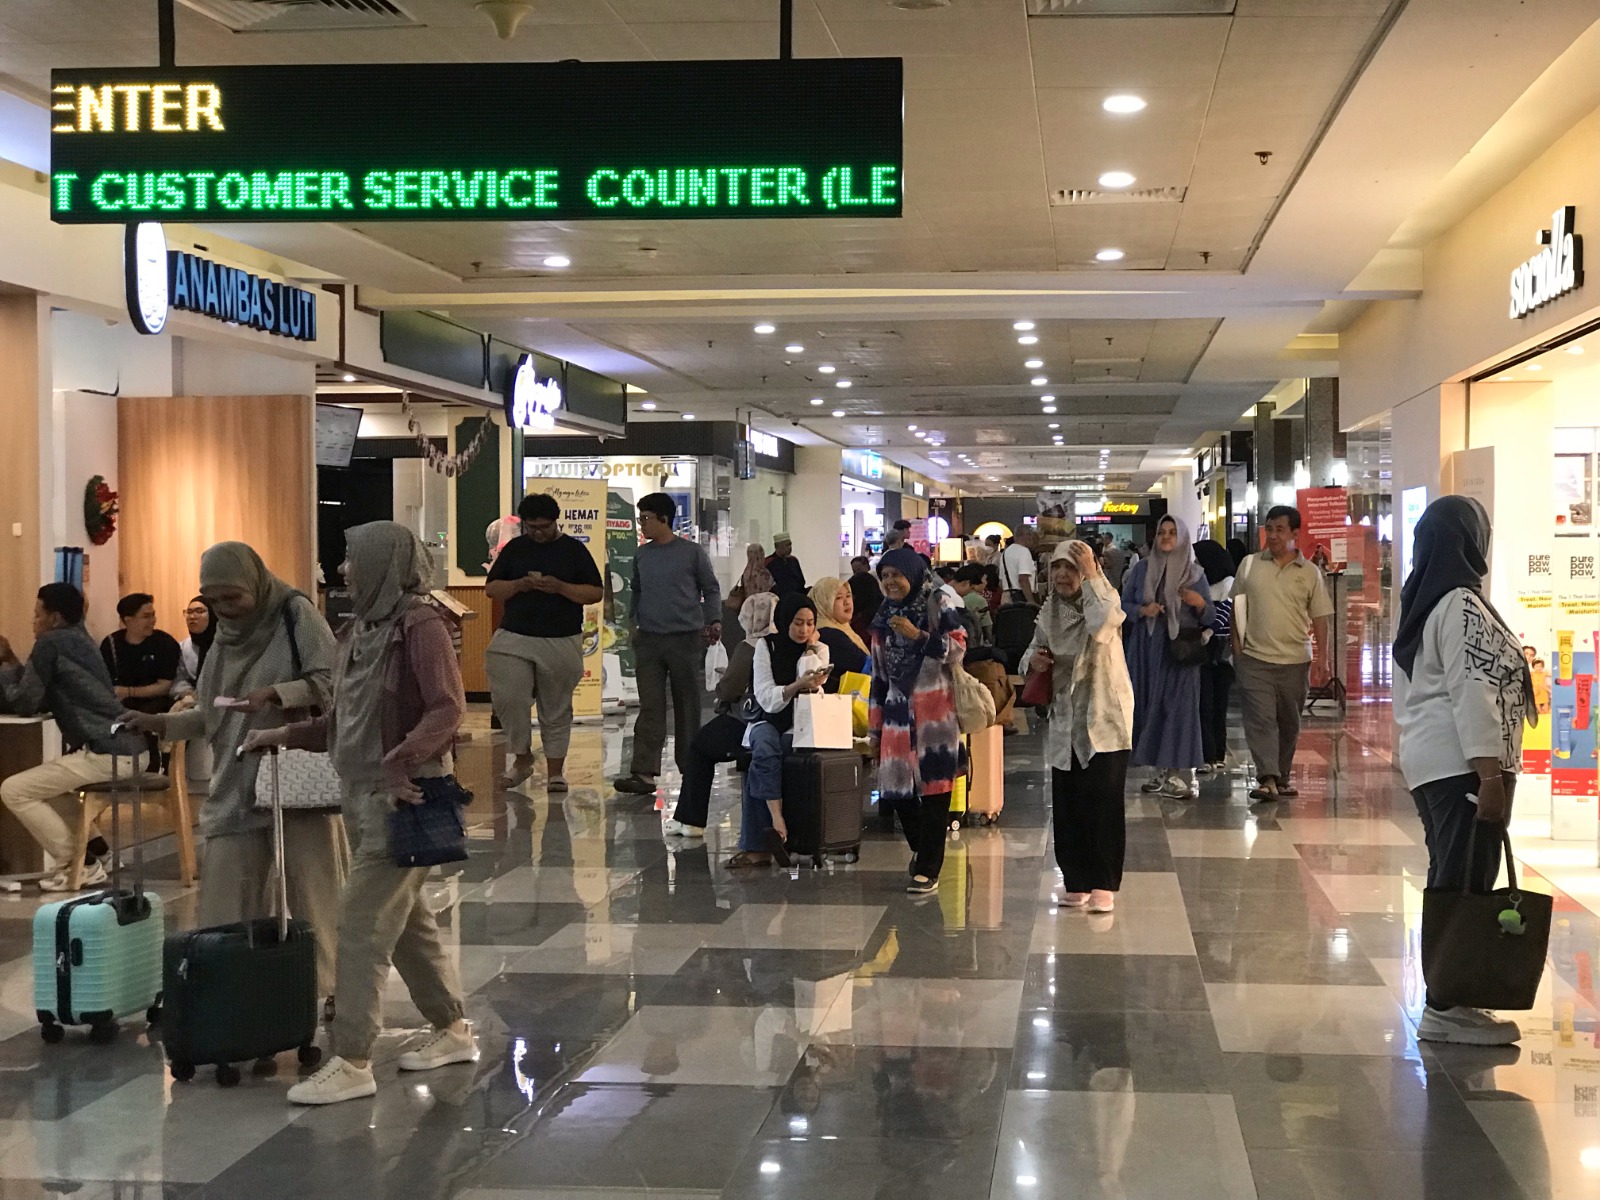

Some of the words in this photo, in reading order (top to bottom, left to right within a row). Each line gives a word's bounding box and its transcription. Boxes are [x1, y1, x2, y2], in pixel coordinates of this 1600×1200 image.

[91, 171, 354, 210] CUSTOMER
[363, 169, 559, 208] SERVICE
[586, 167, 811, 207] COUNTER
[822, 166, 896, 209] (LE
[174, 252, 275, 330] ANAMBAS
[598, 462, 679, 477] OPTICAL
[1104, 501, 1139, 514] Factory
[564, 509, 600, 521] HEMAT
[1528, 560, 1550, 568] paw
[1570, 562, 1594, 570] paw
[1528, 567, 1550, 576] paw
[1570, 569, 1594, 580] paw
